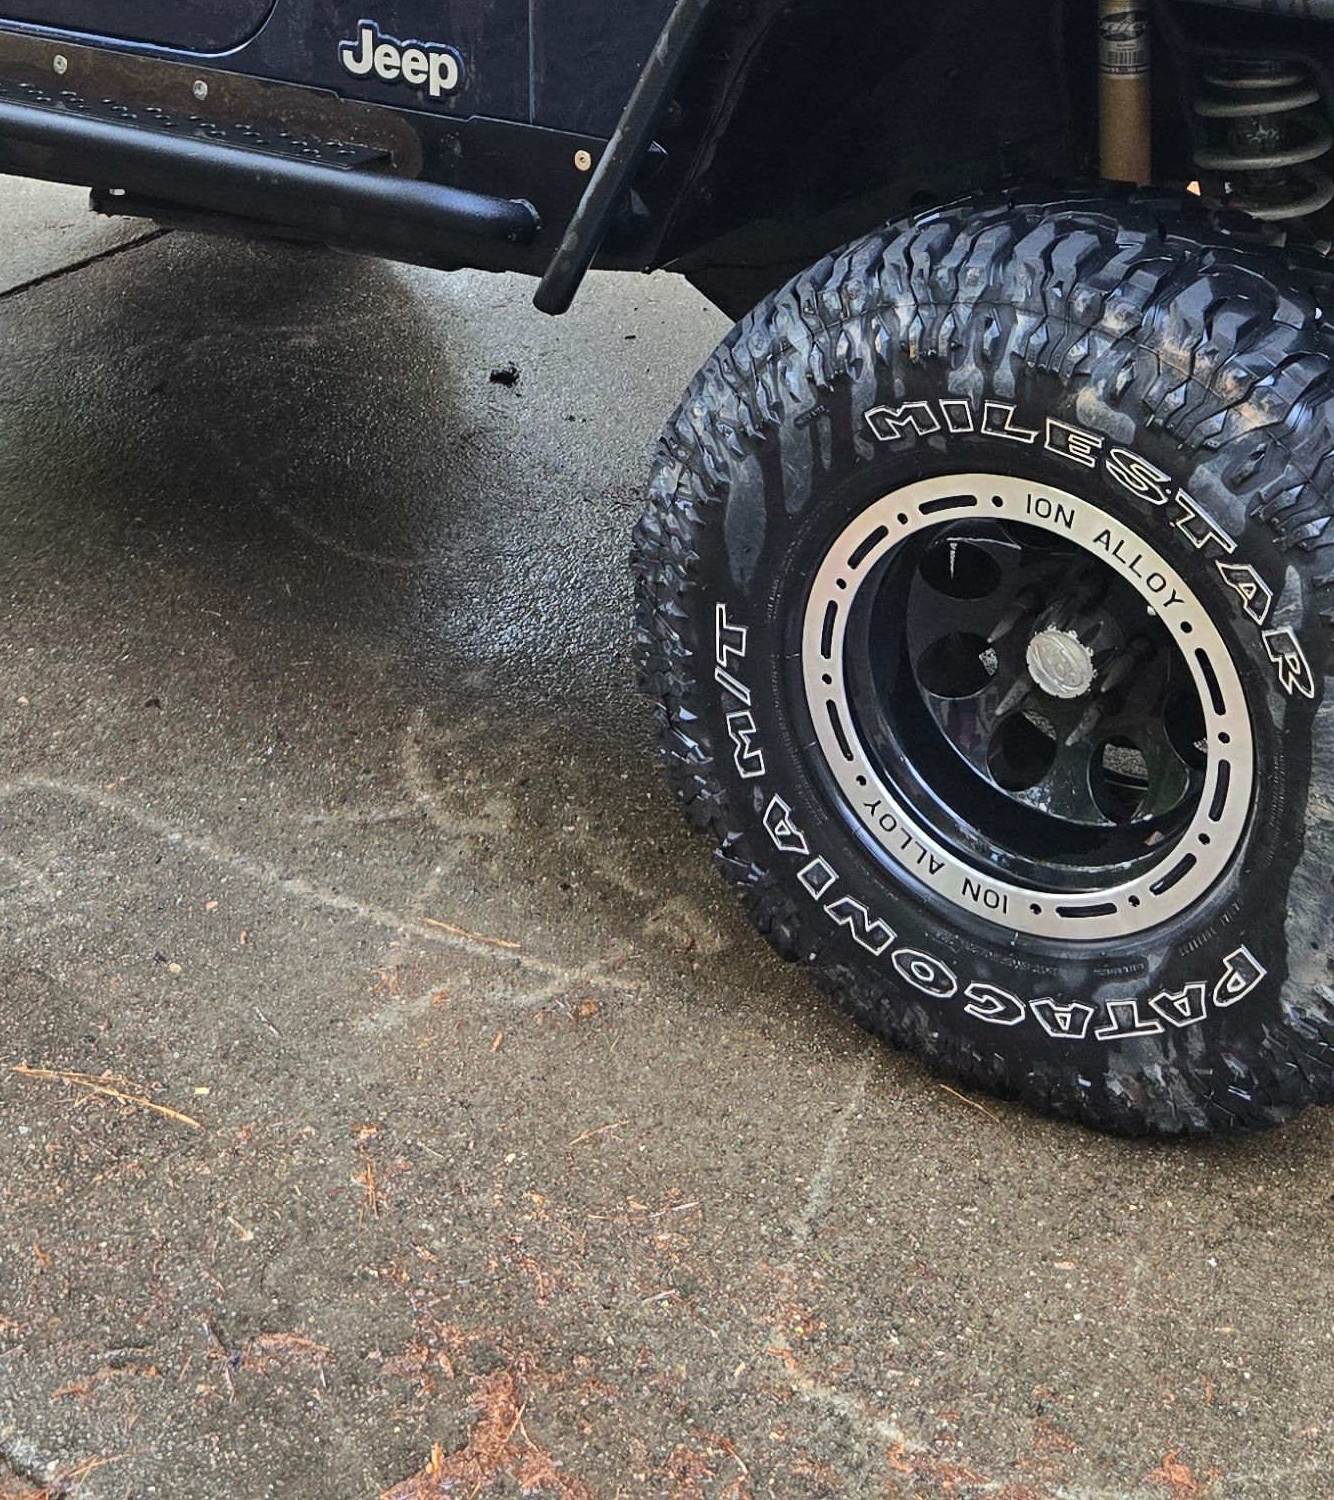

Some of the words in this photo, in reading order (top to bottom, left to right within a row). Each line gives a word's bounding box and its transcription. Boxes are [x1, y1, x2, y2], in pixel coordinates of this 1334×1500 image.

[342, 28, 459, 97] Jeep
[864, 399, 1315, 699] MILESTAR
[1026, 493, 1076, 529] ION
[1092, 528, 1186, 610] ALLOY
[714, 602, 765, 779] M/T
[863, 798, 947, 876] ALLOY
[961, 876, 1009, 915] ION
[762, 793, 1267, 1041] PATAGONIA
